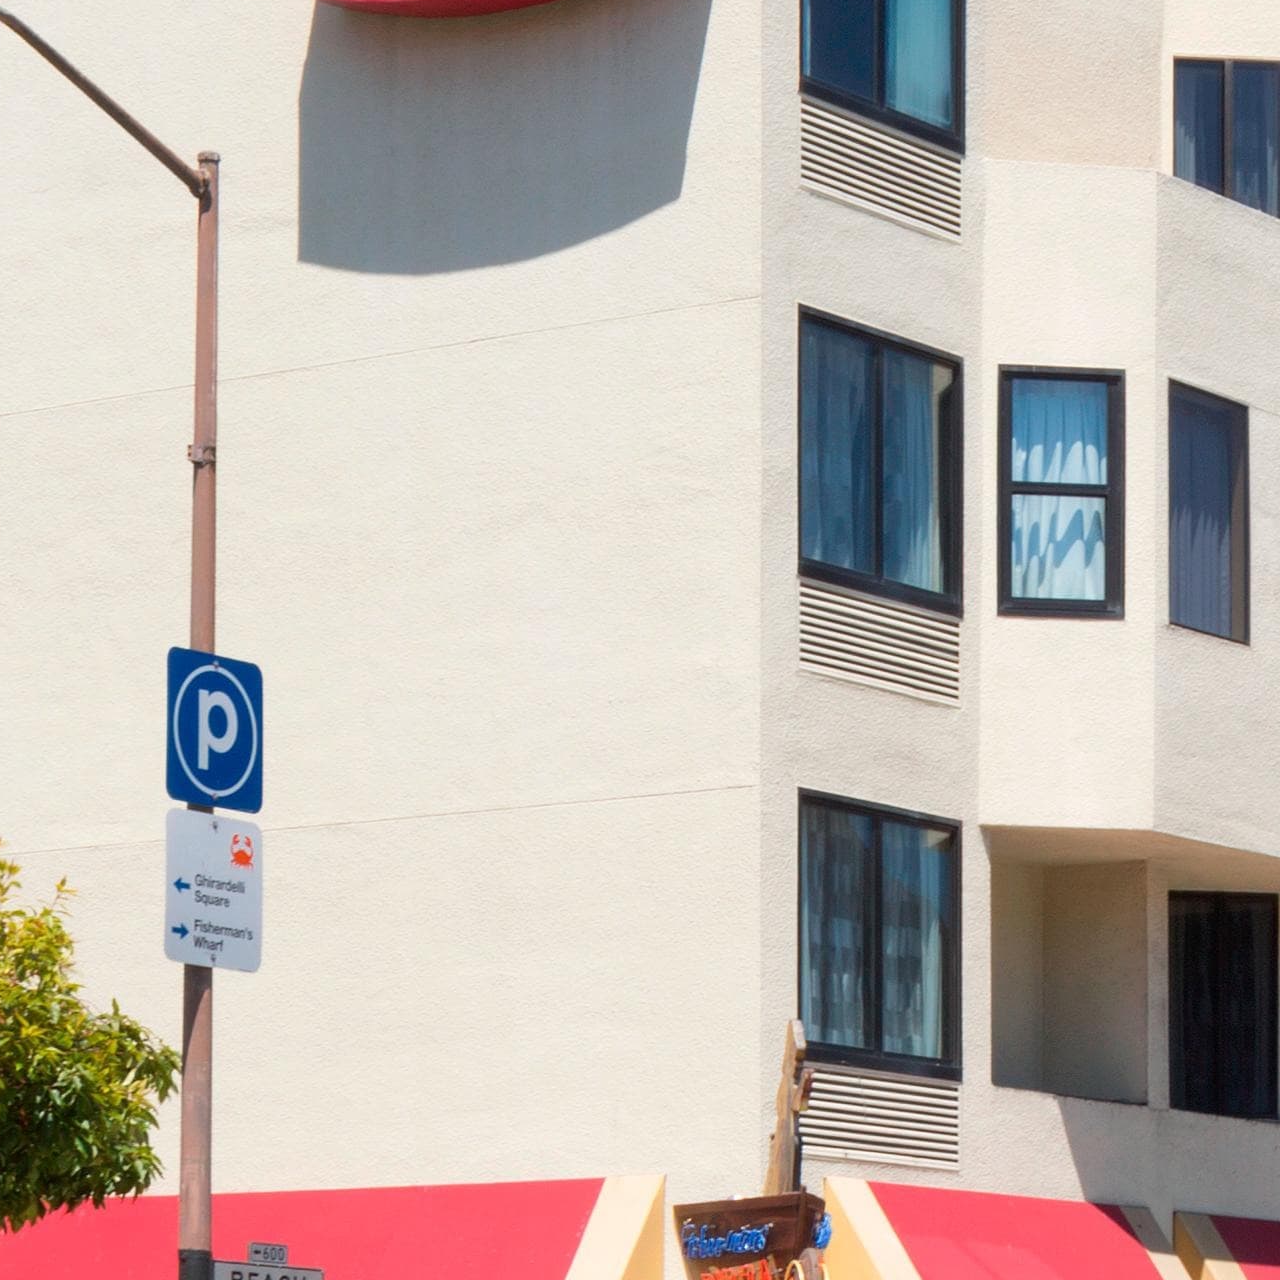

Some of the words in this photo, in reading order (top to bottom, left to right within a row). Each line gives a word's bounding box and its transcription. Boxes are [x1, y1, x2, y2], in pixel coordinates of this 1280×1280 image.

[194, 874, 245, 893] Ghirardelli
[194, 890, 230, 908] Square
[193, 919, 253, 941] Fisherman's
[193, 936, 224, 952] Wharf
[262, 1247, 286, 1261] 600
